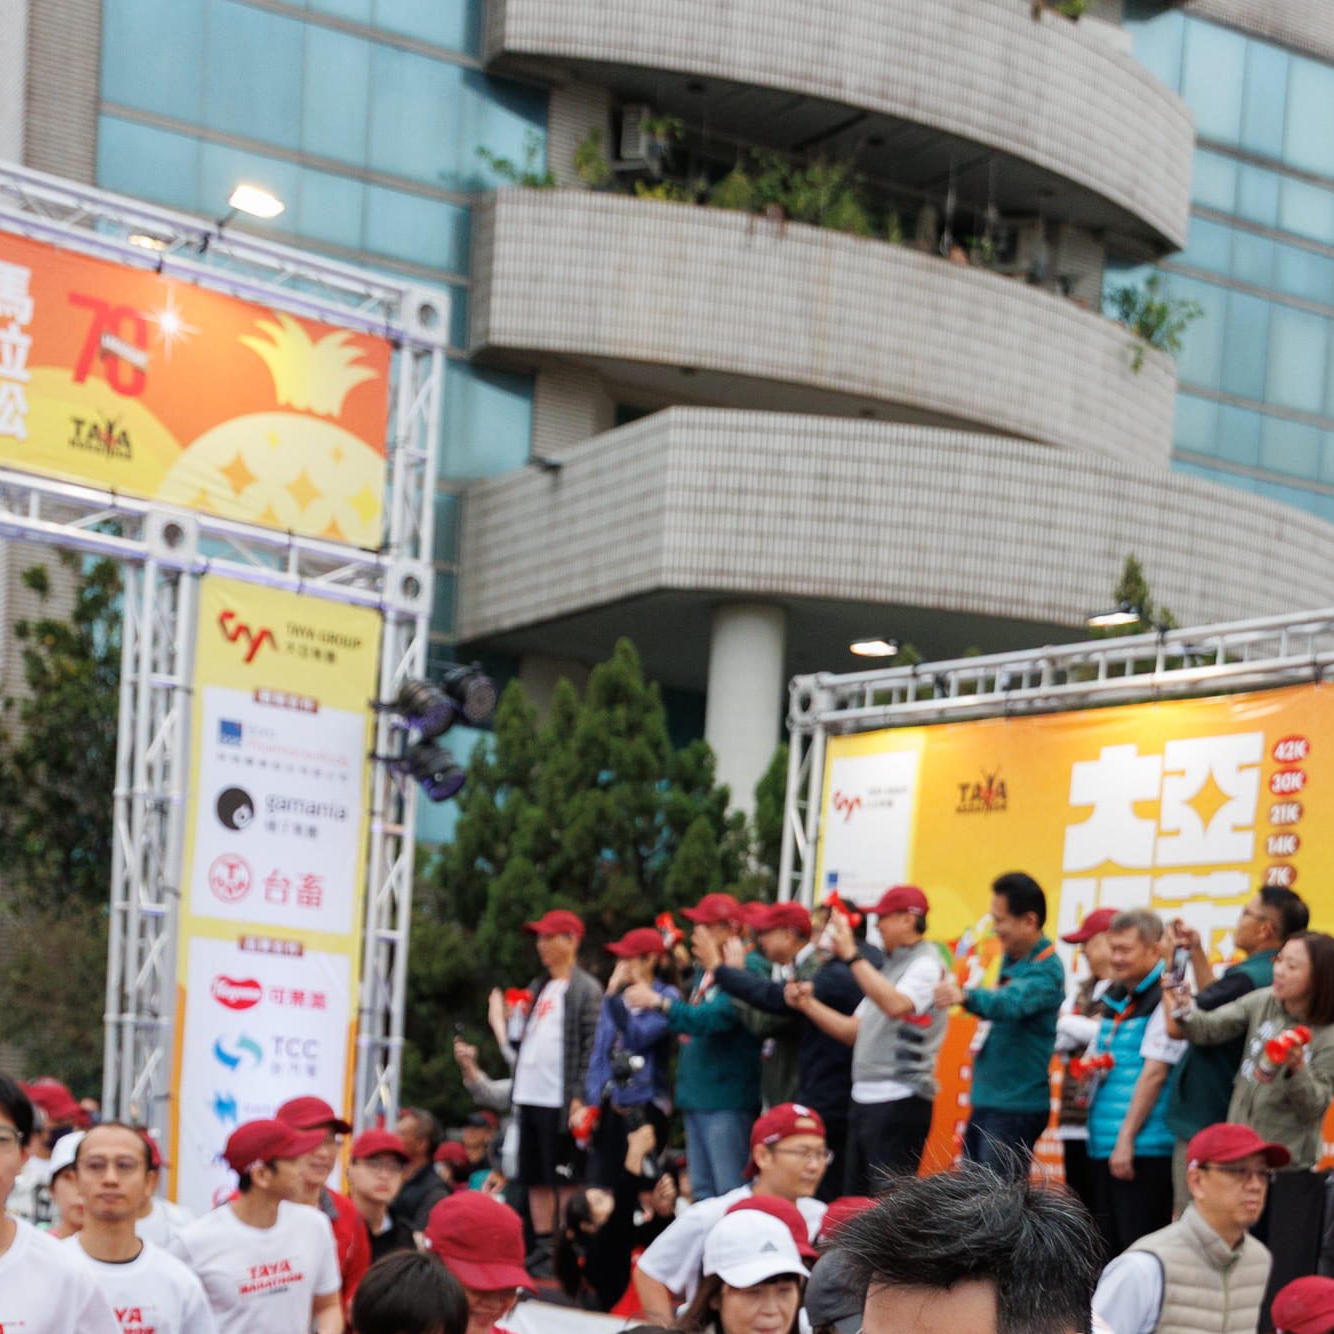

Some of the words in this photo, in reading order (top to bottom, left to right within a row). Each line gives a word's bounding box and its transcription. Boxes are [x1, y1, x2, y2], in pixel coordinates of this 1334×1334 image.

[317, 630, 363, 649] GROUP
[1273, 737, 1308, 761] 42K
[958, 775, 1007, 803] TAYA
[1270, 769, 1305, 793] 30K
[266, 794, 347, 821] gamania
[1269, 802, 1302, 825] 21K
[1266, 835, 1298, 856] 14K
[1266, 864, 1293, 886] 7K
[262, 867, 323, 908] 台畜
[271, 1034, 318, 1060] TCC
[249, 1259, 291, 1280] TAYA
